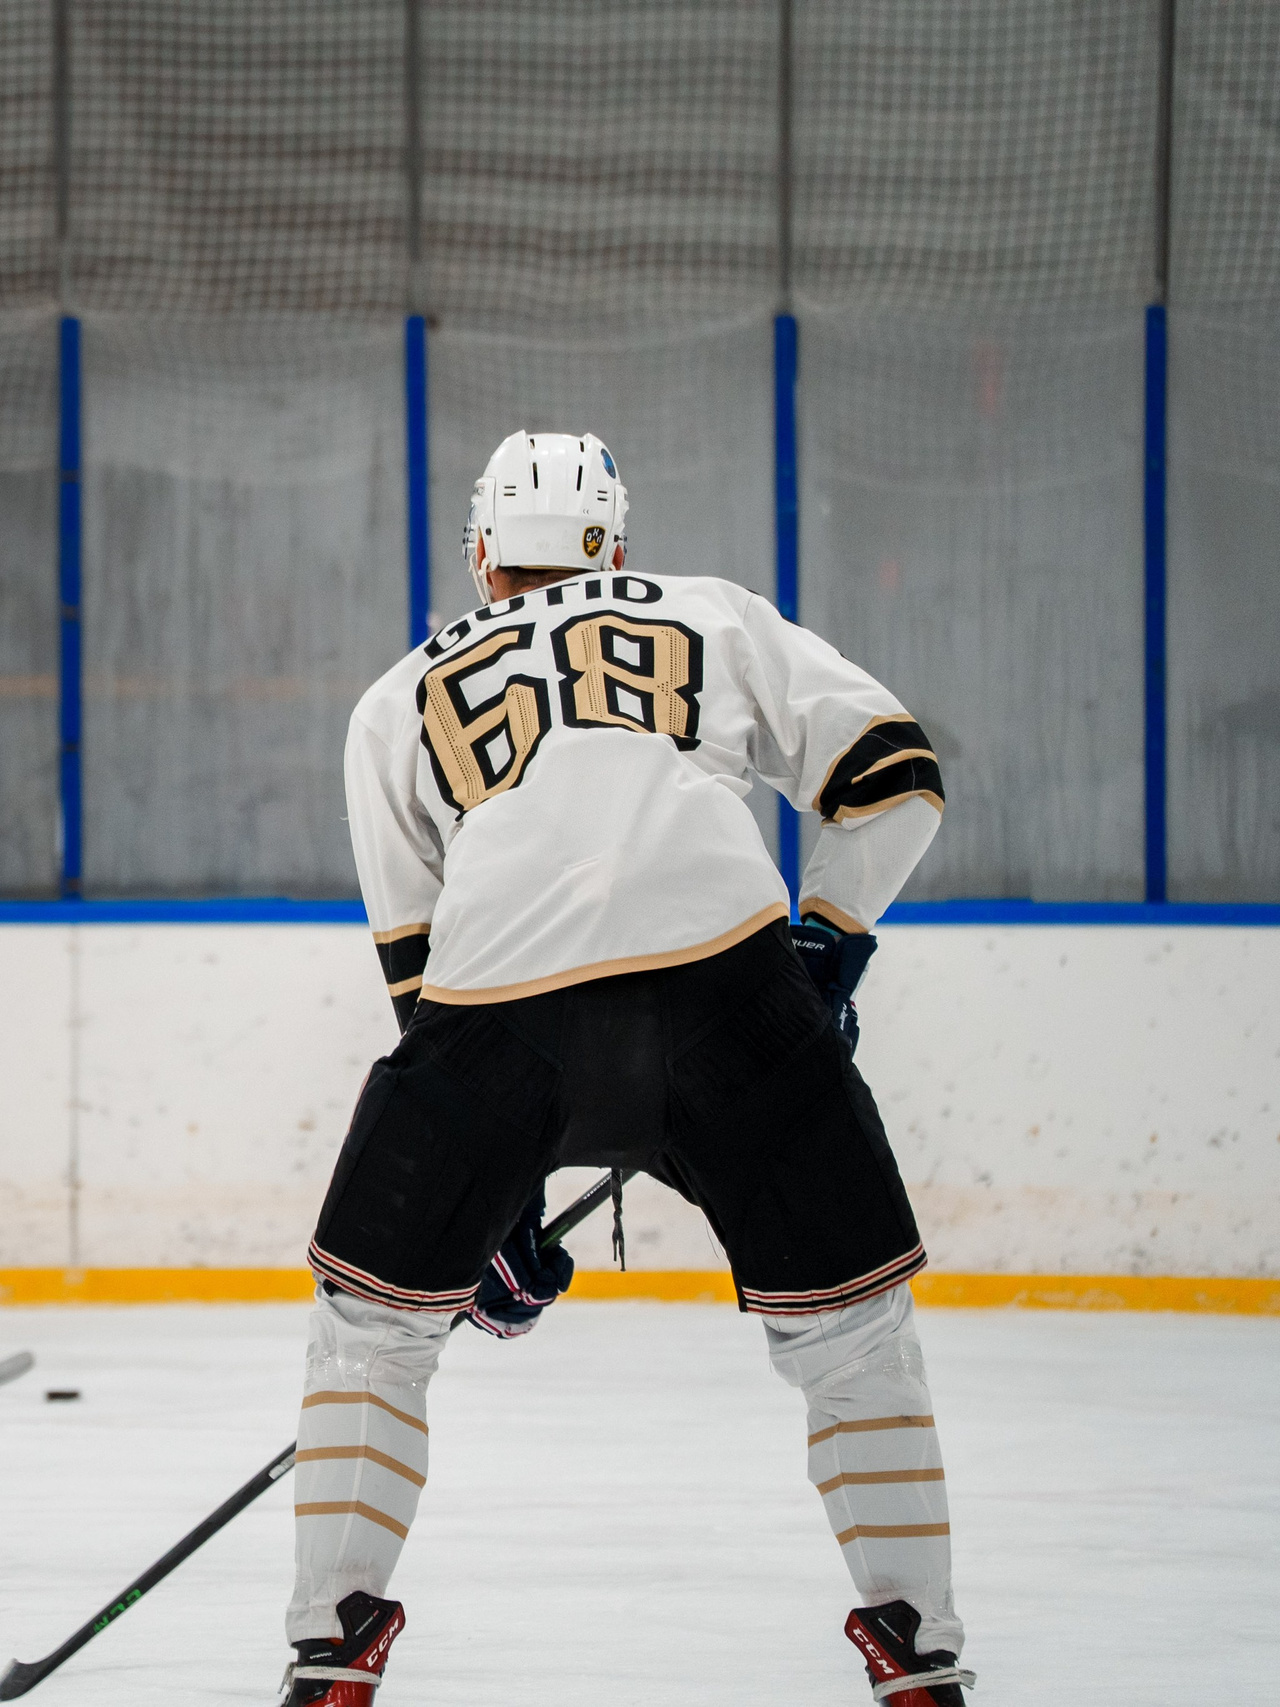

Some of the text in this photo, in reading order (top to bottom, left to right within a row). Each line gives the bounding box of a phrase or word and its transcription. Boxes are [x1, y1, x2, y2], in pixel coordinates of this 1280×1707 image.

[416, 609, 704, 822] 68
[366, 1618, 399, 1668] CCM
[852, 1627, 895, 1675] CCM
